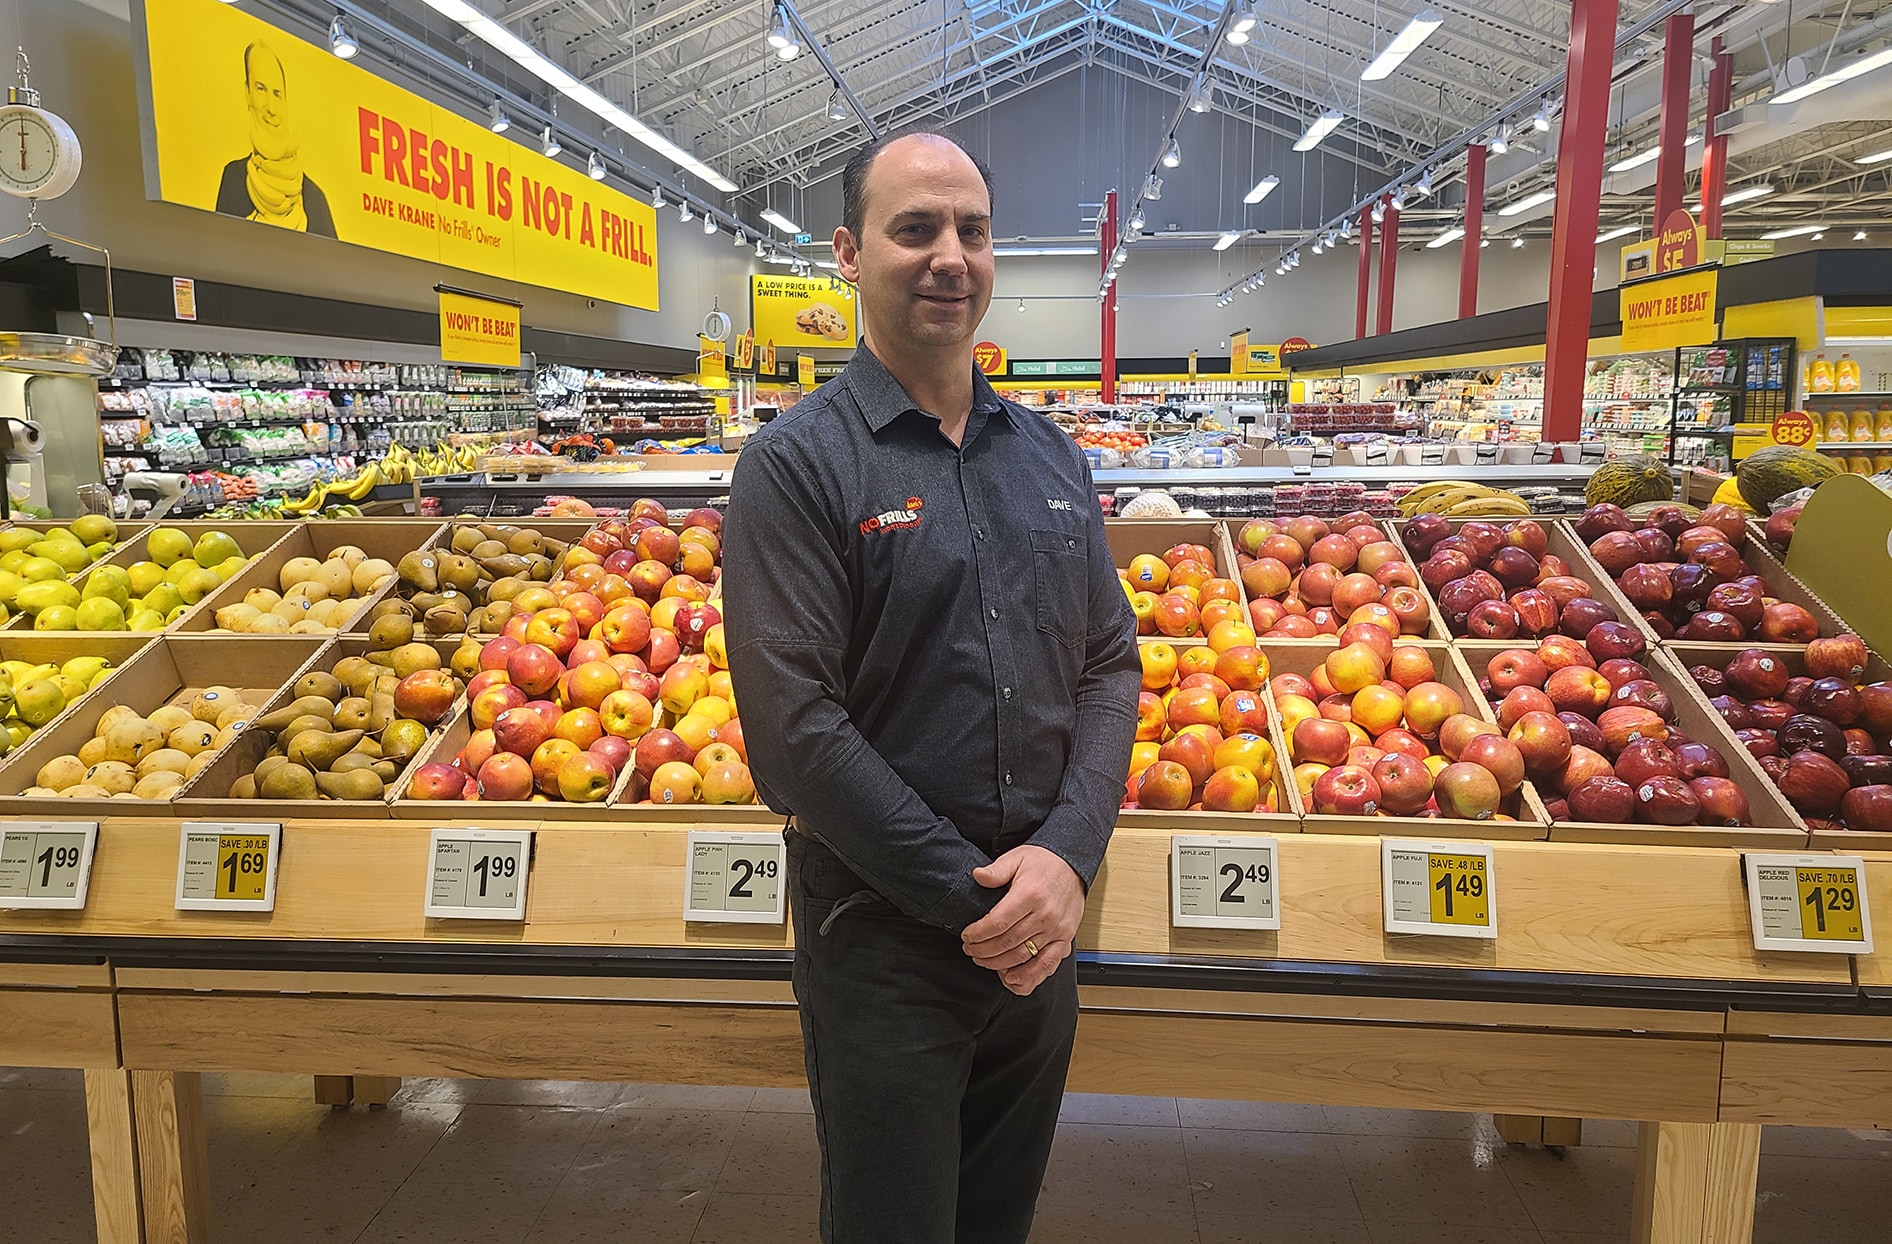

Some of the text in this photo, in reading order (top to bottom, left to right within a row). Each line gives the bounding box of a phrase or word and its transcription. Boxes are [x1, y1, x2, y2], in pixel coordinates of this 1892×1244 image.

[358, 106, 653, 268] FRESH IS NOT A FRILL.
[363, 193, 394, 218] DAVE
[398, 203, 436, 230] KRANE
[438, 214, 452, 235] No
[476, 226, 501, 248] Owner
[1662, 228, 1692, 247] Always
[766, 281, 783, 289] LOW
[786, 282, 806, 291] PRICE
[757, 289, 811, 299] SWEET THING.
[1628, 299, 1662, 320] WON'T
[1665, 296, 1678, 315] BE
[446, 311, 515, 338] WON'T BE BEAT
[975, 347, 998, 355] Always
[976, 354, 994, 369] $7
[1778, 418, 1808, 426] Always
[1047, 499, 1072, 511] DAVE
[221, 839, 267, 849] SAVE .30 /LB
[1430, 858, 1484, 871] SAVE .48 /LB
[1799, 872, 1855, 884] SAVE .70 /LB
